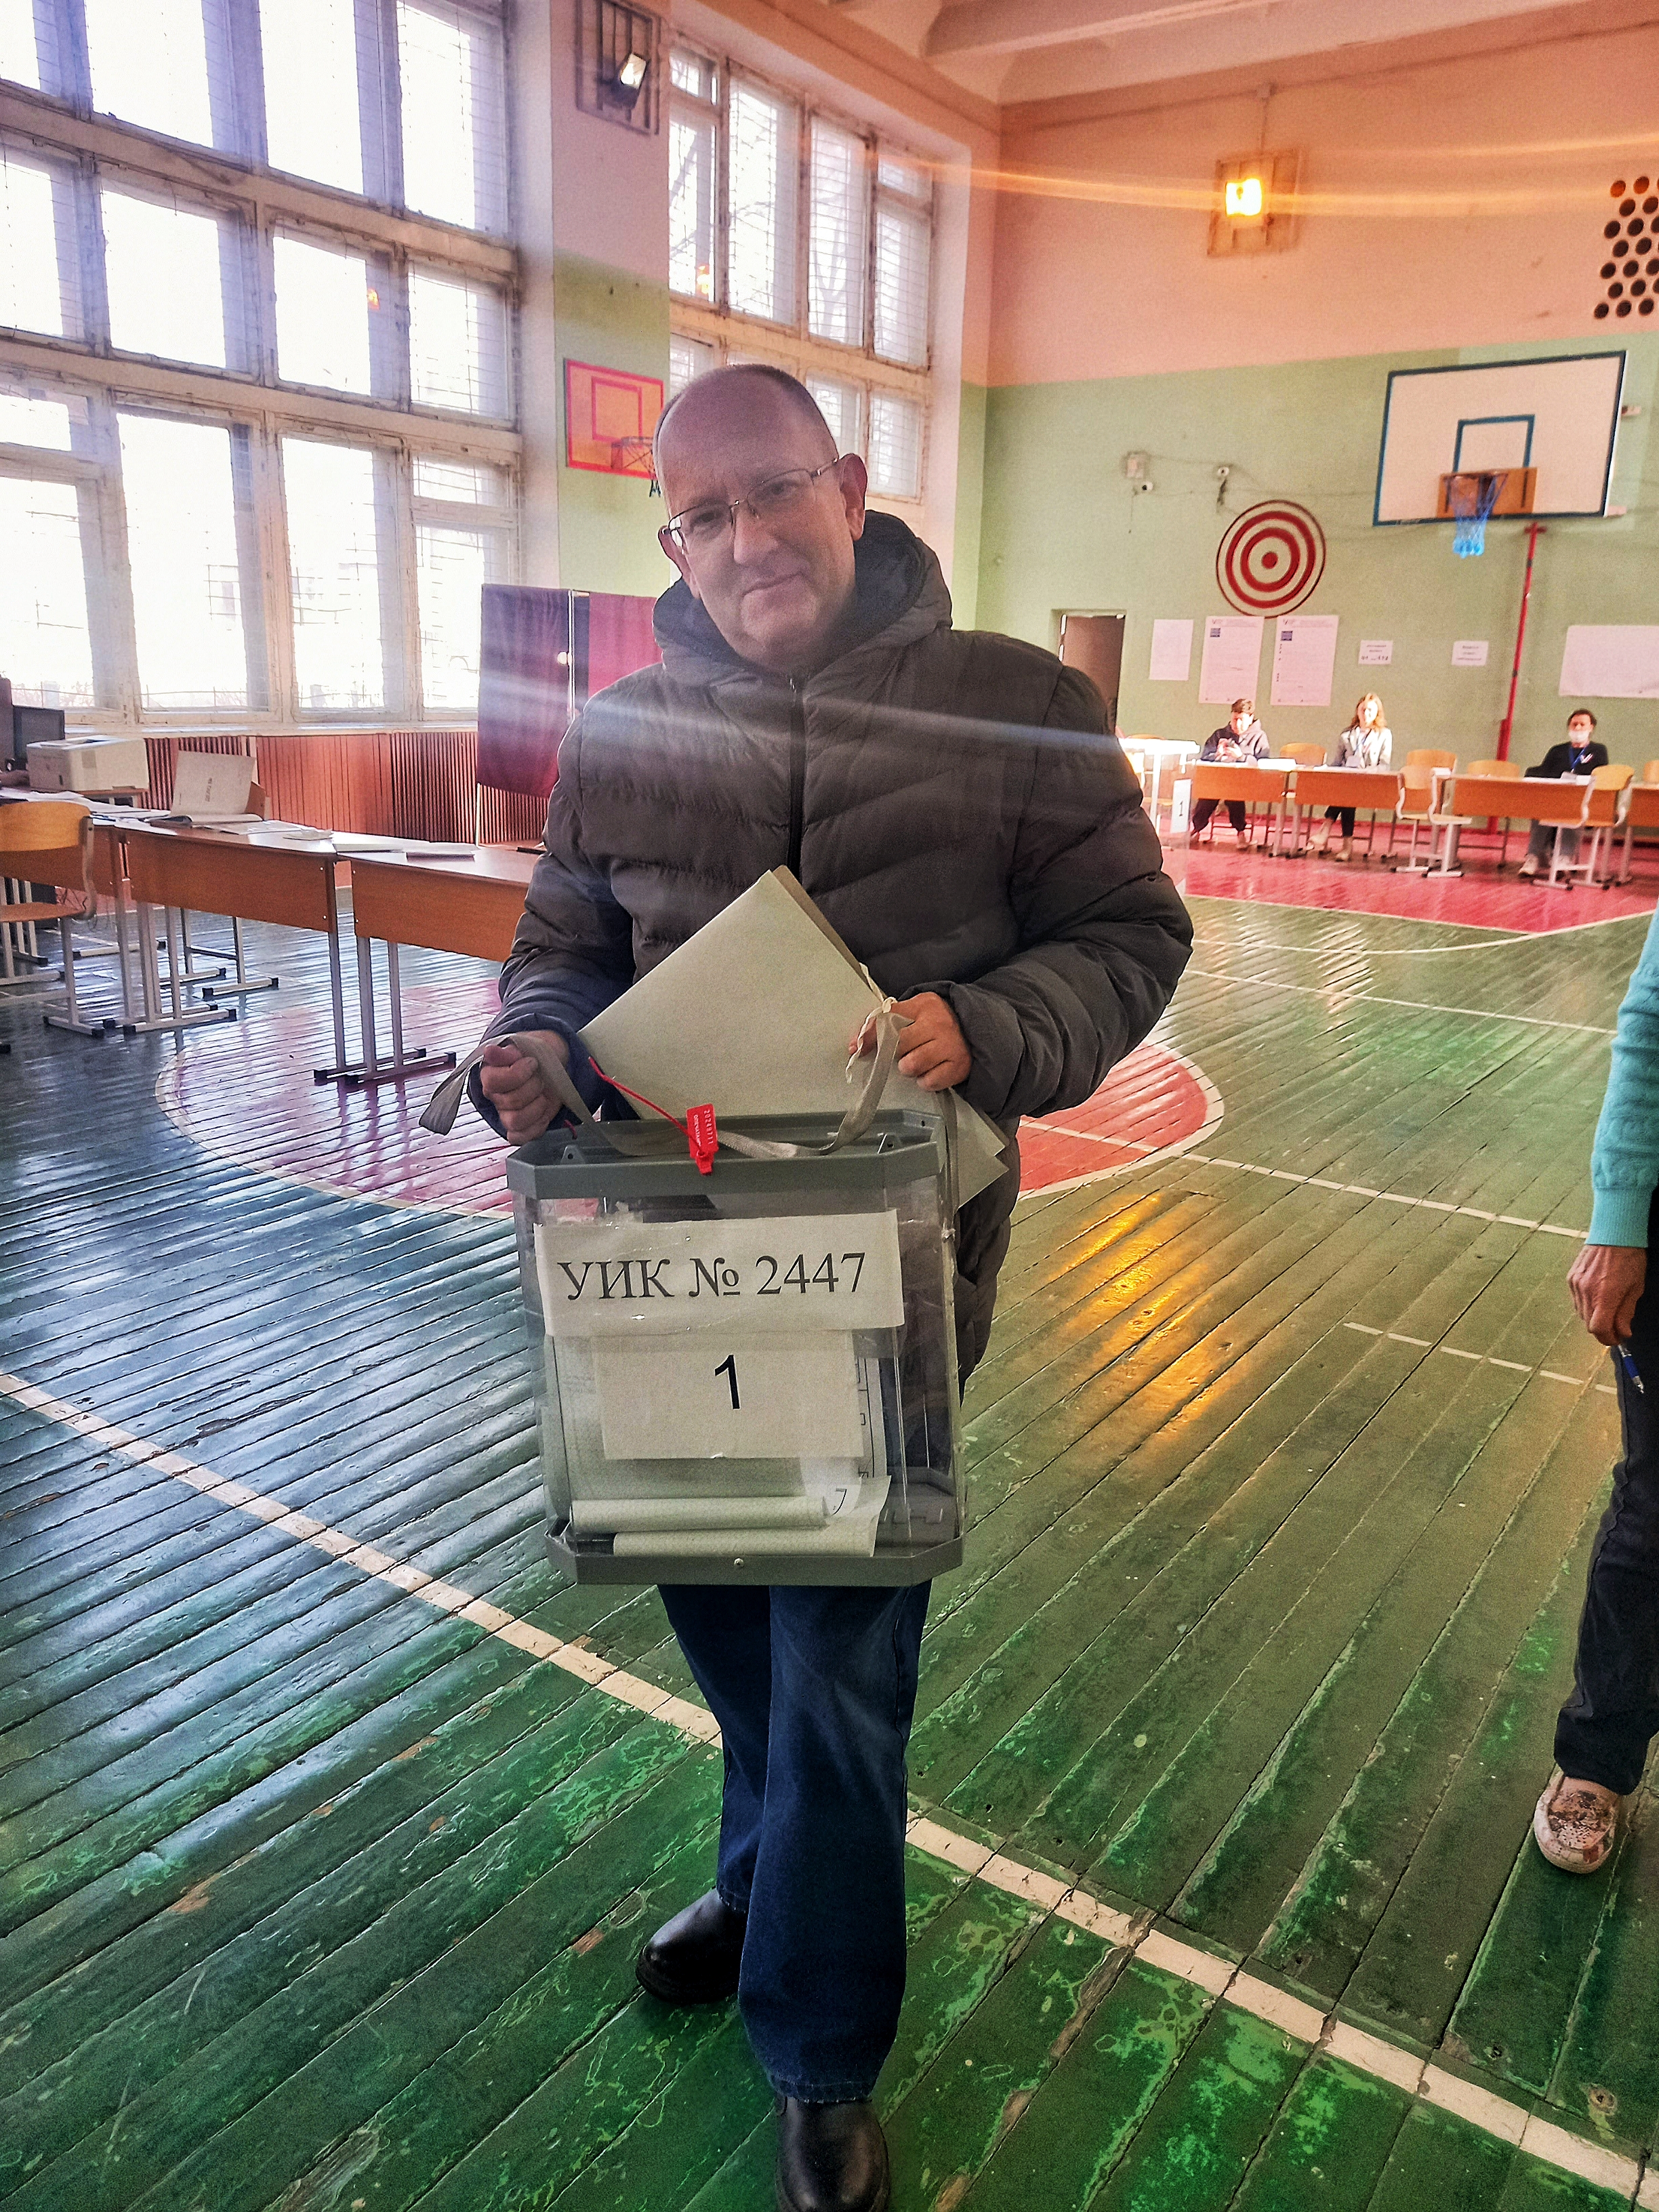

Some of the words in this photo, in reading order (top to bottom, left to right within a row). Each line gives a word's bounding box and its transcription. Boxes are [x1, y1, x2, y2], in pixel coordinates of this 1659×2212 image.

[1179, 800, 1184, 817] 1
[557, 1258, 675, 1300] УИК
[689, 1257, 741, 1297] №
[755, 1252, 865, 1295] 2447
[714, 1354, 741, 1410] 1
